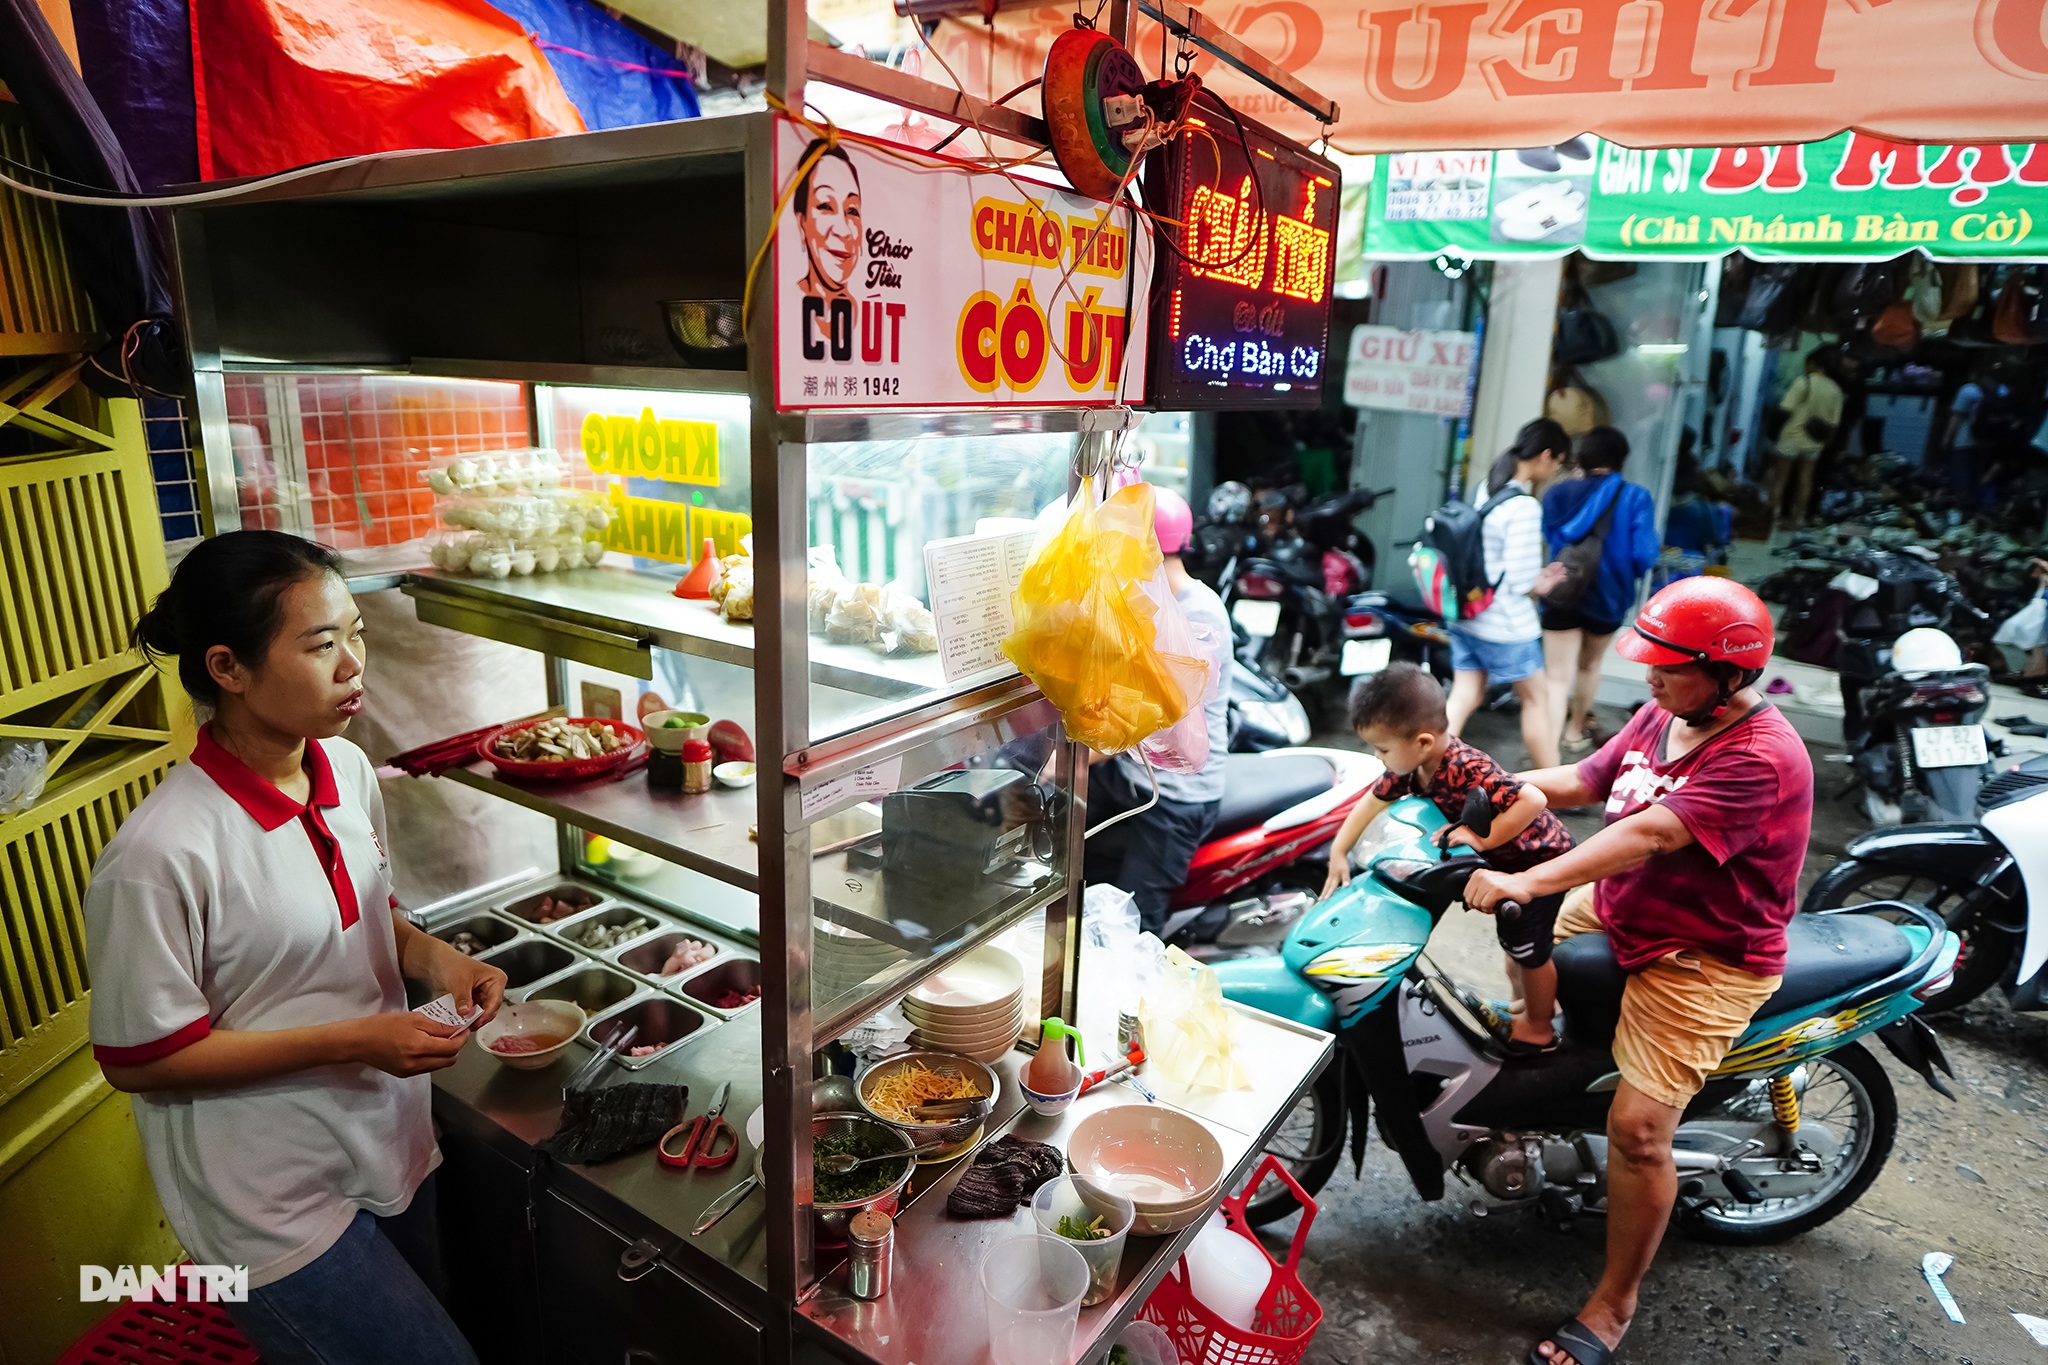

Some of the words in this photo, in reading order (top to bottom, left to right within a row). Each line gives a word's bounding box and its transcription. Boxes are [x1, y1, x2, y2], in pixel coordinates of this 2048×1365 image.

[865, 228, 914, 260] Cháo
[974, 206, 1062, 261] CHÁO
[1069, 217, 1125, 270] TIỀU
[1619, 213, 1700, 247] (Chi
[1709, 213, 1844, 245] Nhánh
[1853, 213, 1939, 243] Bàn
[1950, 208, 2034, 246] Cờ)
[865, 260, 902, 289] Tiều
[861, 293, 907, 363] ÚT
[960, 287, 1047, 385] CÔ
[1184, 334, 1236, 378] Chợ
[1241, 340, 1286, 376] Bàn
[863, 377, 900, 397] 1942
